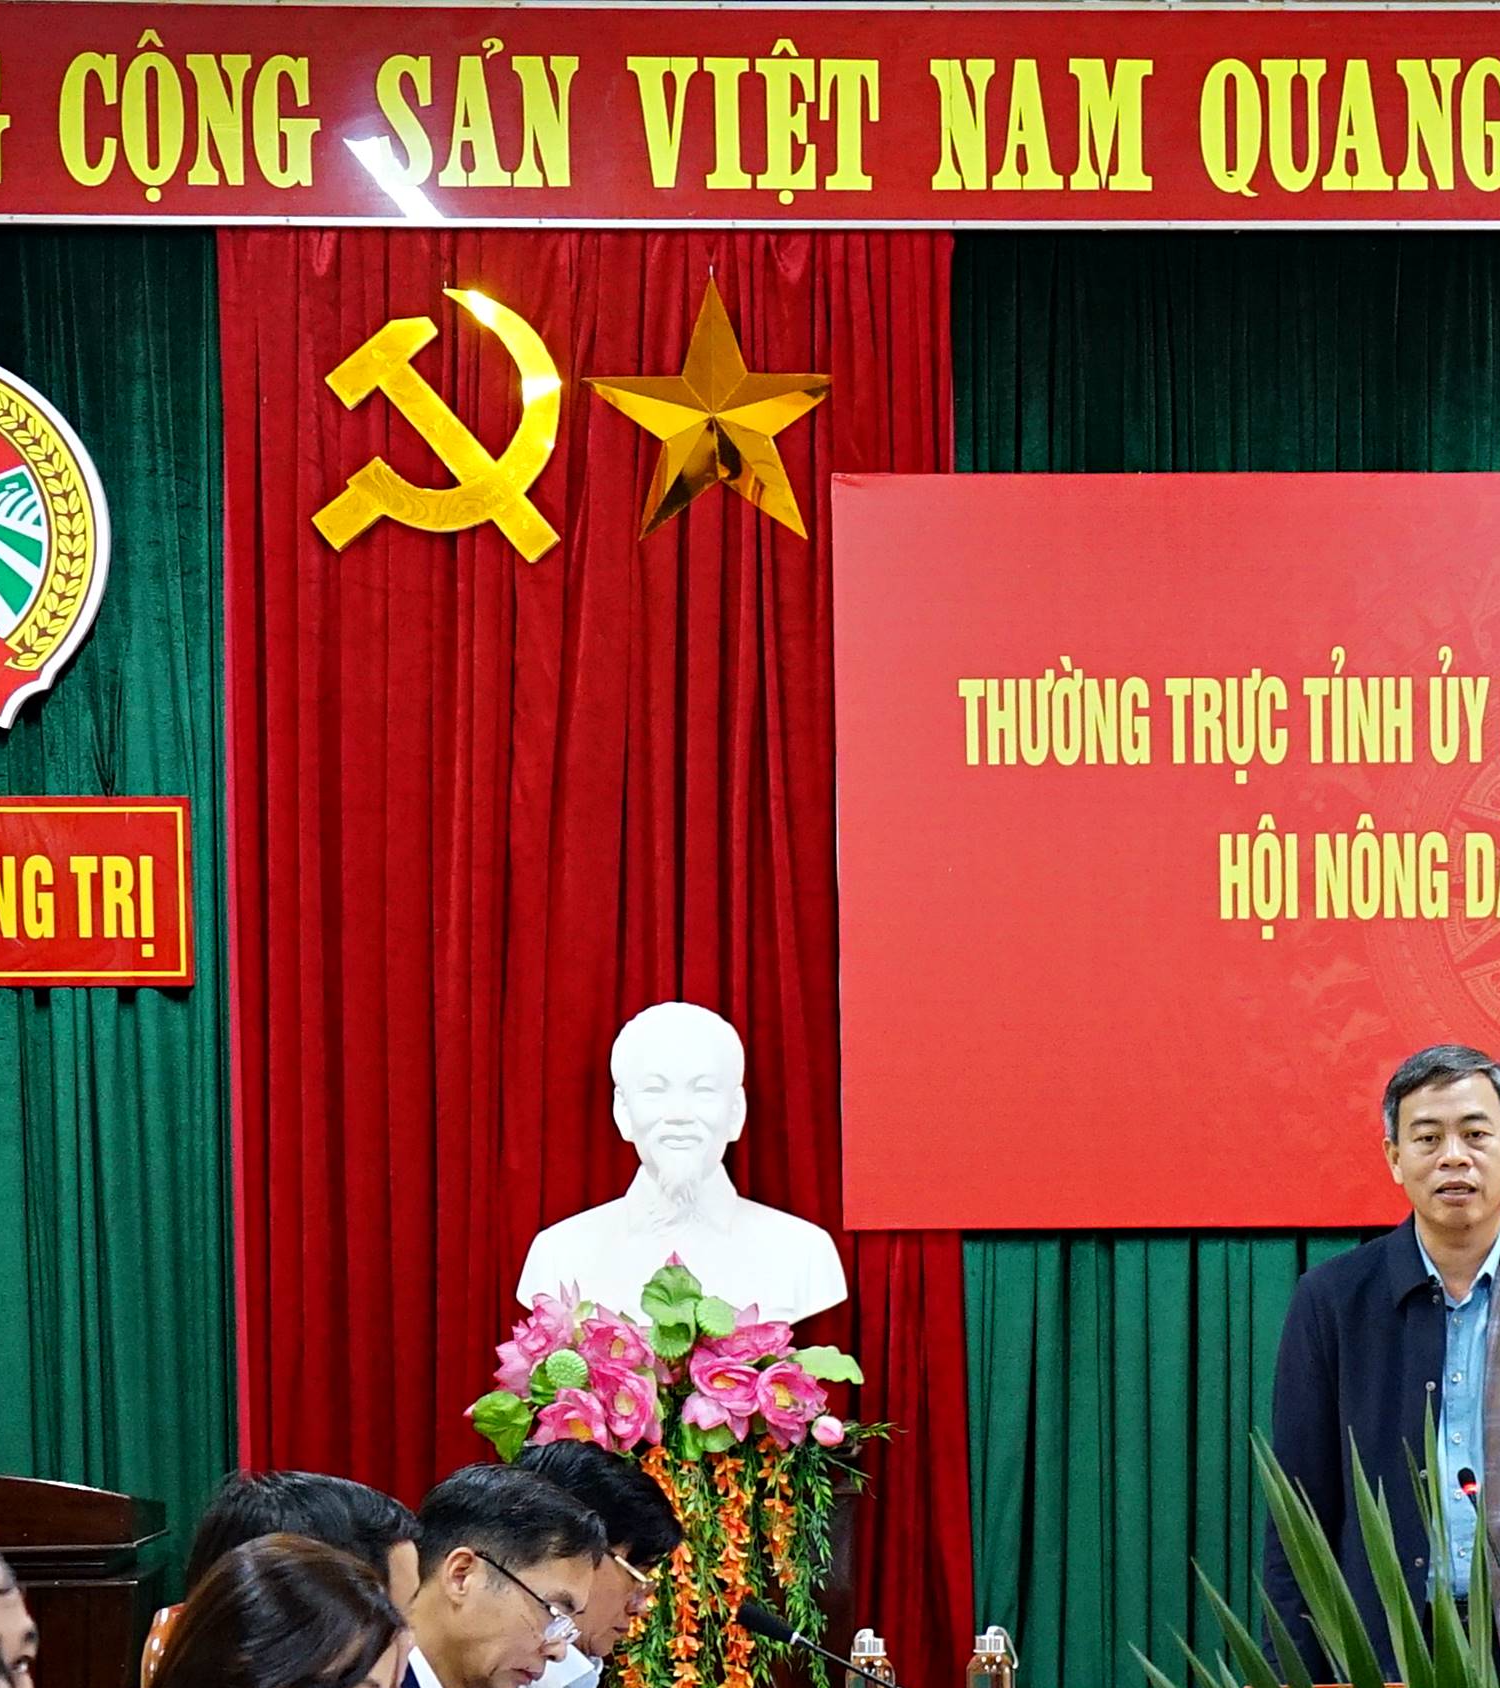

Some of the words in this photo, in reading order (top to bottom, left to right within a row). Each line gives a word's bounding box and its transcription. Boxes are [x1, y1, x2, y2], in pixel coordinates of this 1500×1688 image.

[58, 28, 321, 203] CỘNG
[372, 37, 581, 190] SẢN
[628, 37, 880, 206] VIỆT
[931, 57, 1154, 193] NAM
[958, 656, 1152, 768] THƯỜNG
[1165, 670, 1290, 785] TRỰC
[1303, 645, 1415, 764] TỈNH
[1430, 644, 1490, 766] ỦY
[70, 855, 156, 959] TRỊ
[1219, 815, 1301, 942] HỘI
[1315, 815, 1451, 922] NÔNG
